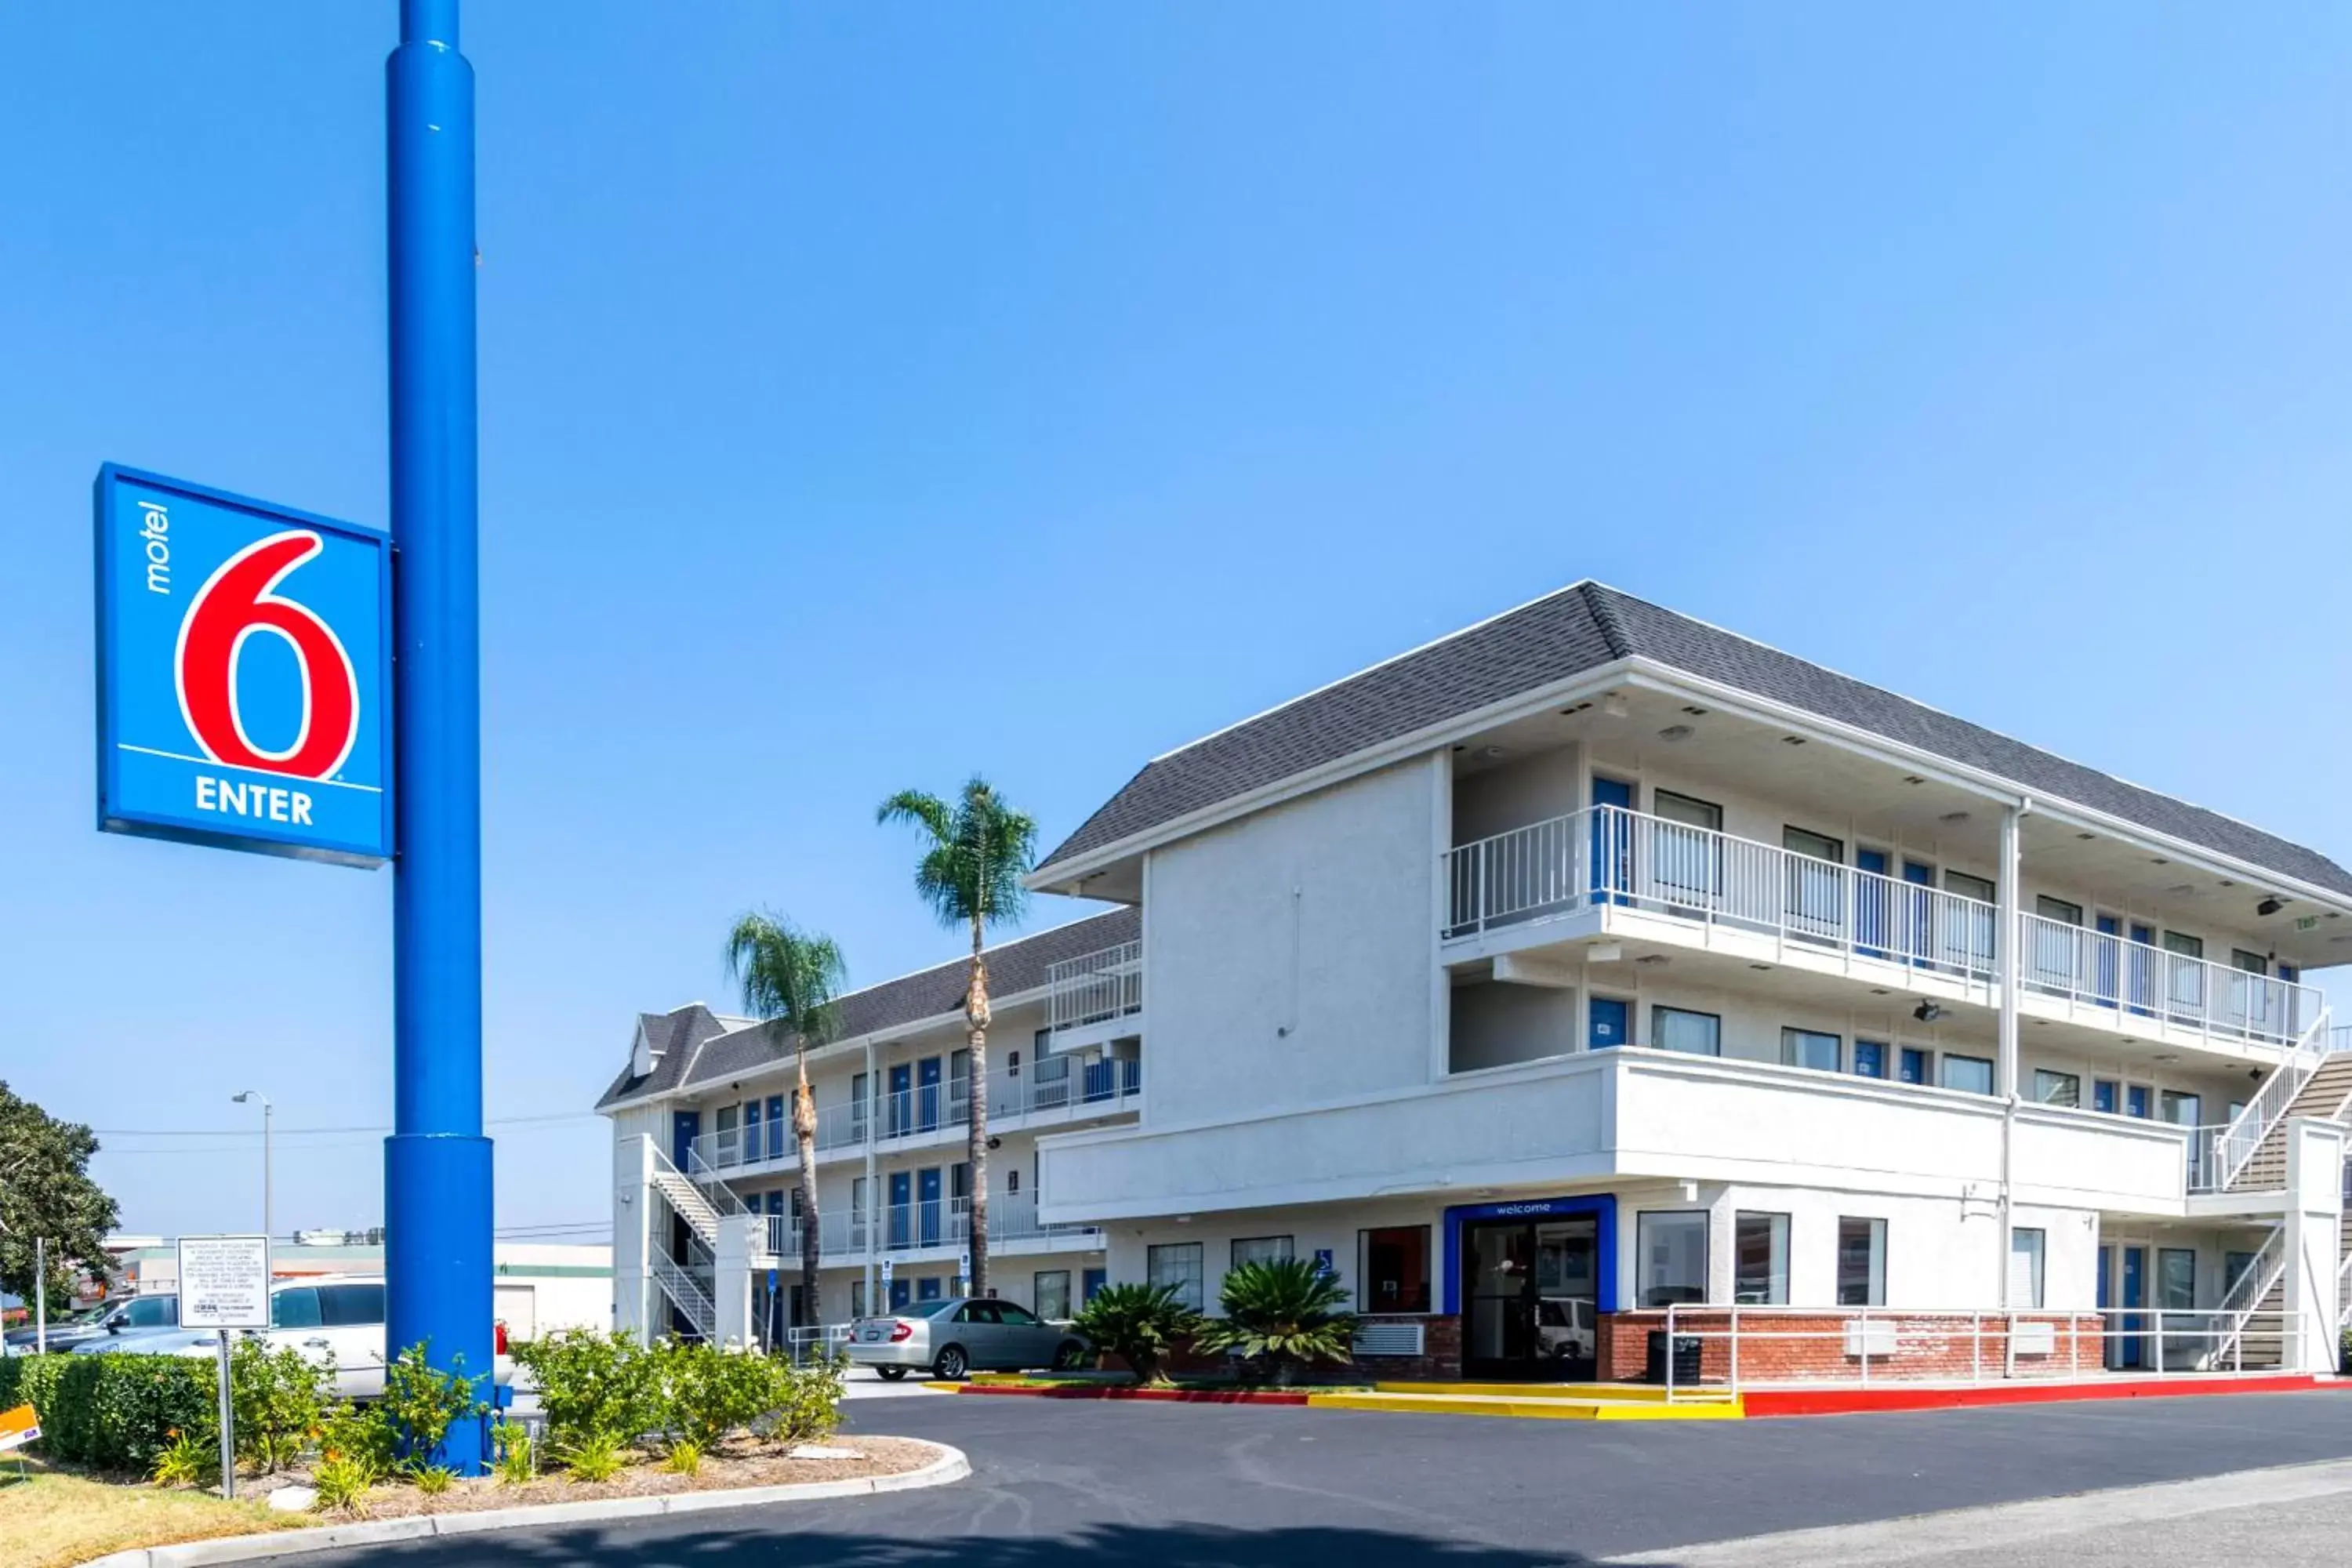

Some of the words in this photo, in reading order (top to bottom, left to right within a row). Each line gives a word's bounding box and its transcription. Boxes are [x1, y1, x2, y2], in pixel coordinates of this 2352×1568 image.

[138, 501, 170, 595] motel
[174, 529, 360, 782] 6
[196, 775, 313, 826] ENTER
[1497, 1203, 1551, 1214] welcome
